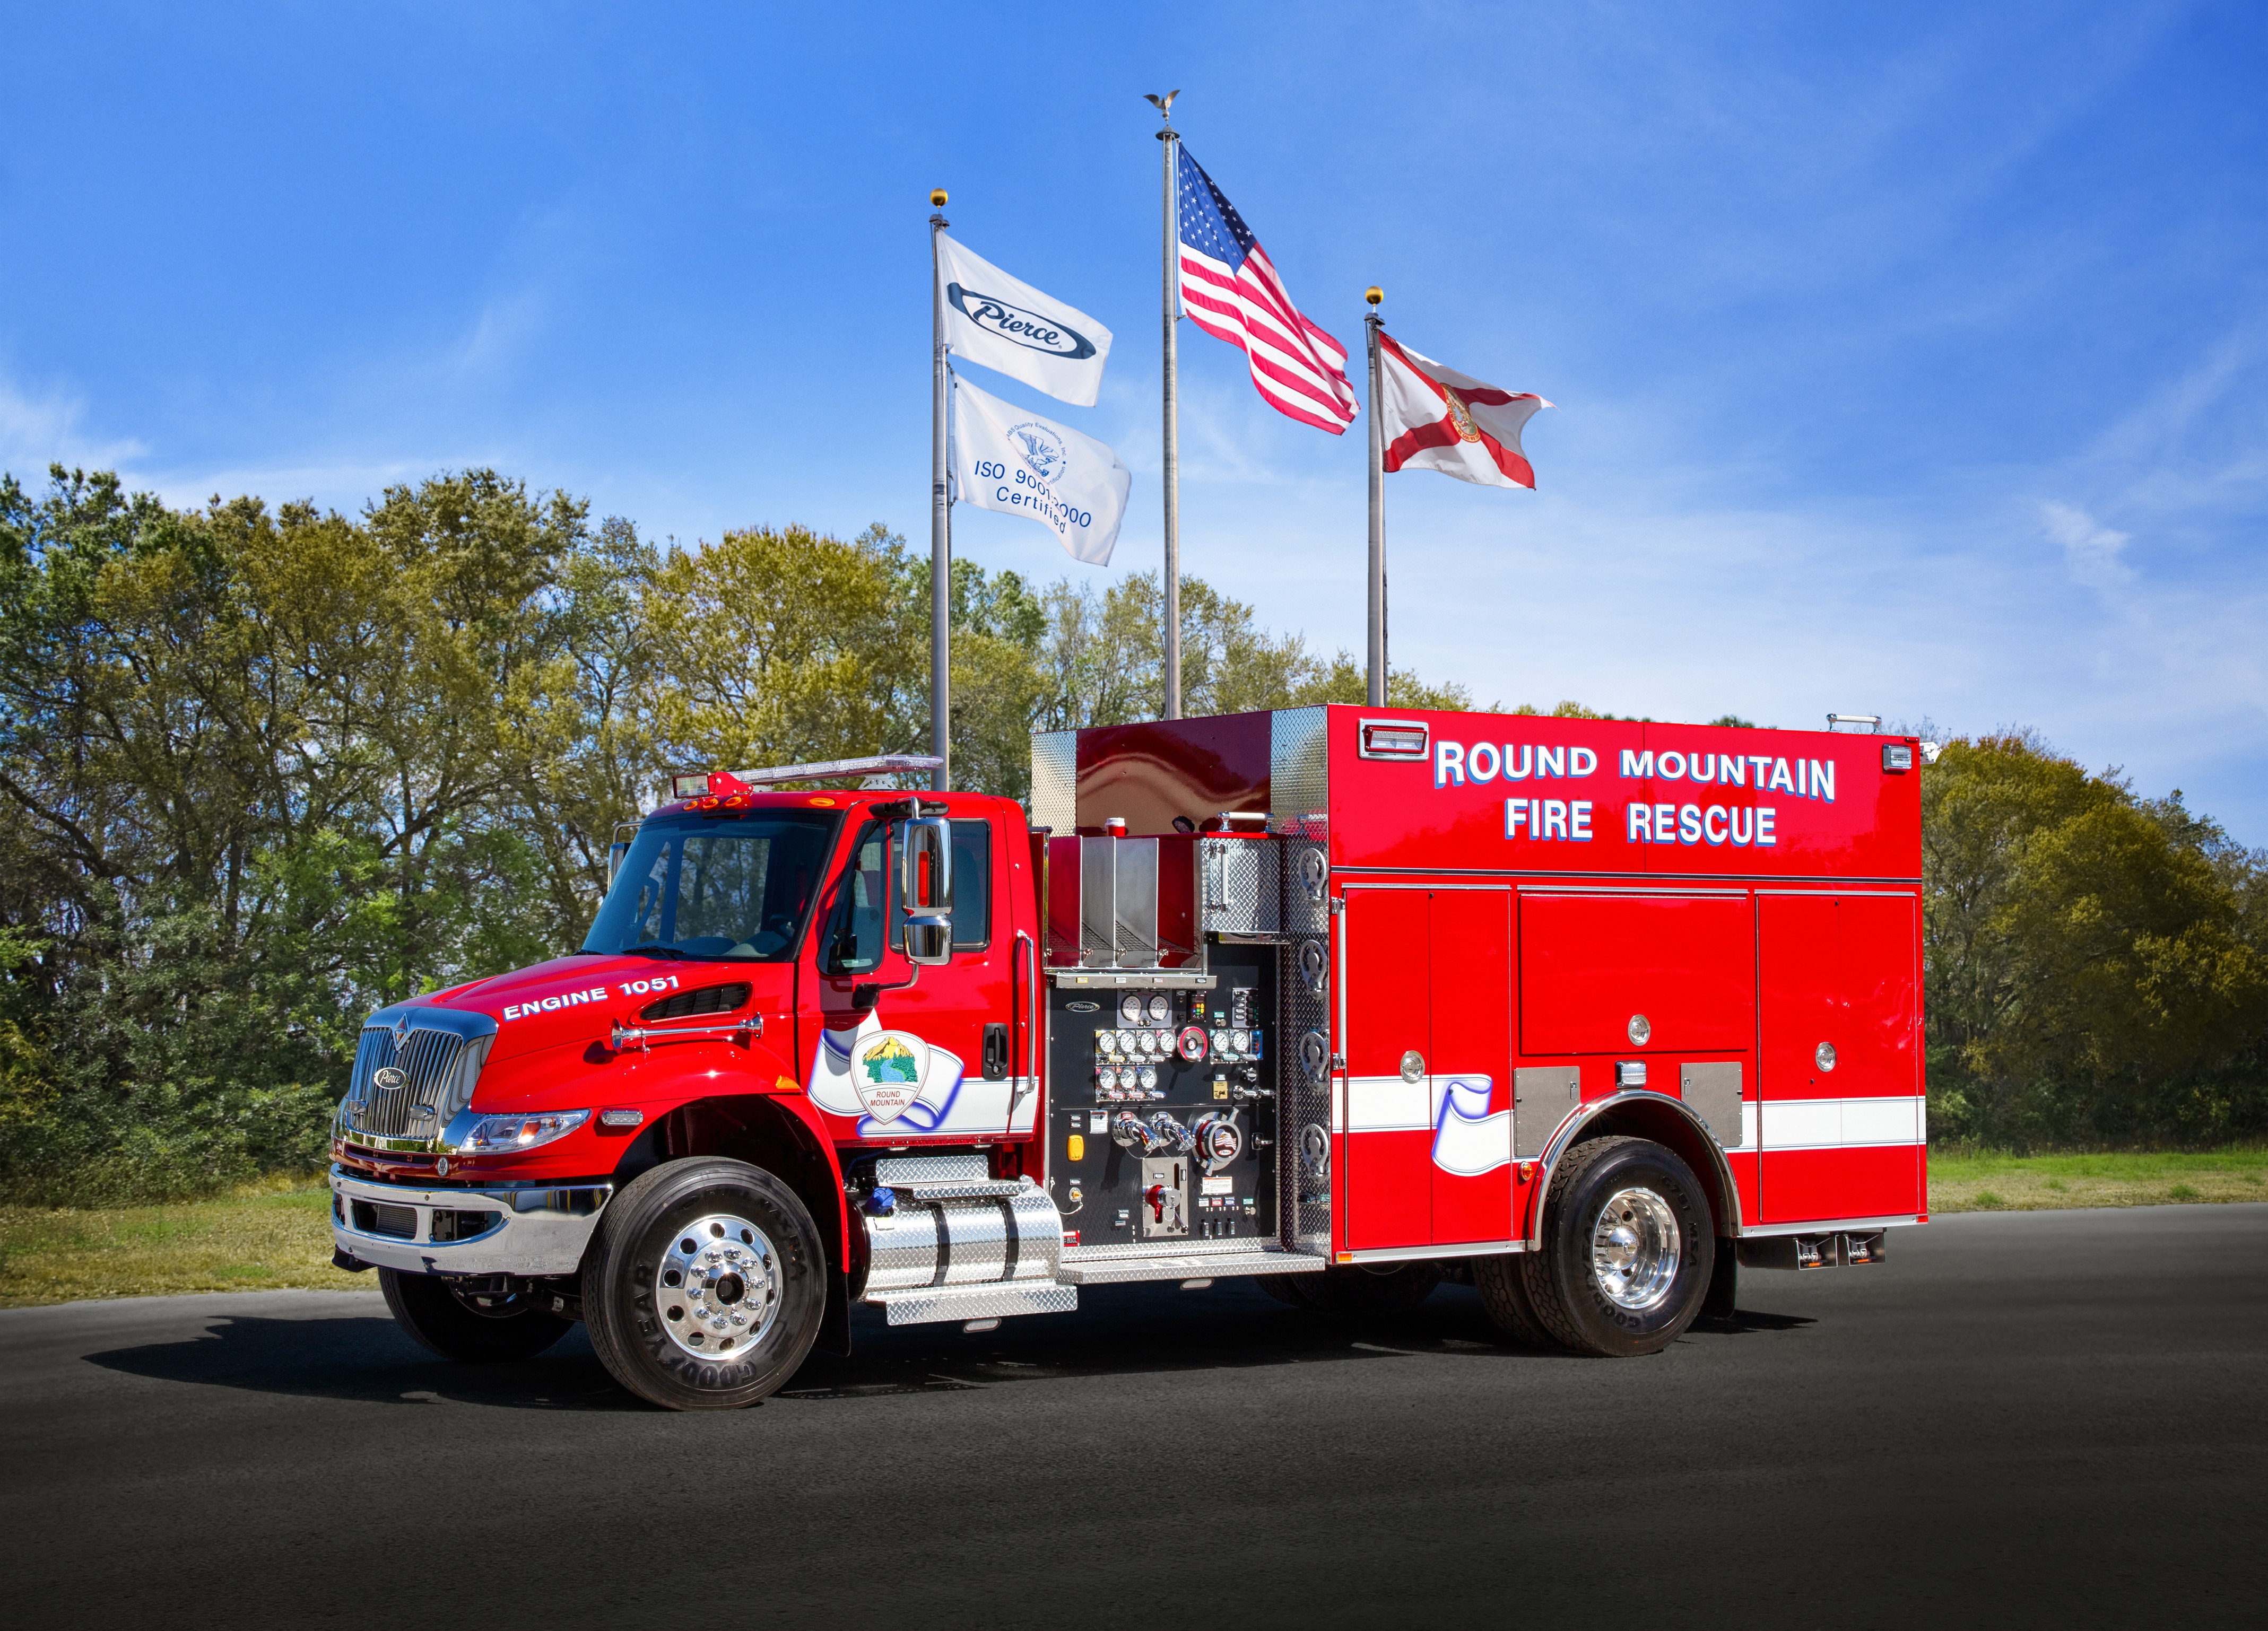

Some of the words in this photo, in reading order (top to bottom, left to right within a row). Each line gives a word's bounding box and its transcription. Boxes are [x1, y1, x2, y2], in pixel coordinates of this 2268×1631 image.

[973, 301, 1060, 345] Pierce
[1006, 428, 1015, 438] ABS
[1035, 422, 1063, 447] Evaluations,
[975, 460, 1005, 479] ISO
[1015, 469, 1091, 527] 9001:2000
[996, 486, 1066, 534] Certified
[1434, 740, 1598, 789] ROUND
[1619, 749, 1835, 804] MOUNTAIN
[1505, 797, 1593, 842] FIRE
[1627, 802, 1776, 847] RESCUE
[502, 987, 609, 1023] ENGINE
[618, 975, 679, 996] 1051
[380, 1069, 401, 1085] Pierce
[757, 1197, 792, 1231] MAX
[633, 1264, 757, 1386] GOODYEAR
